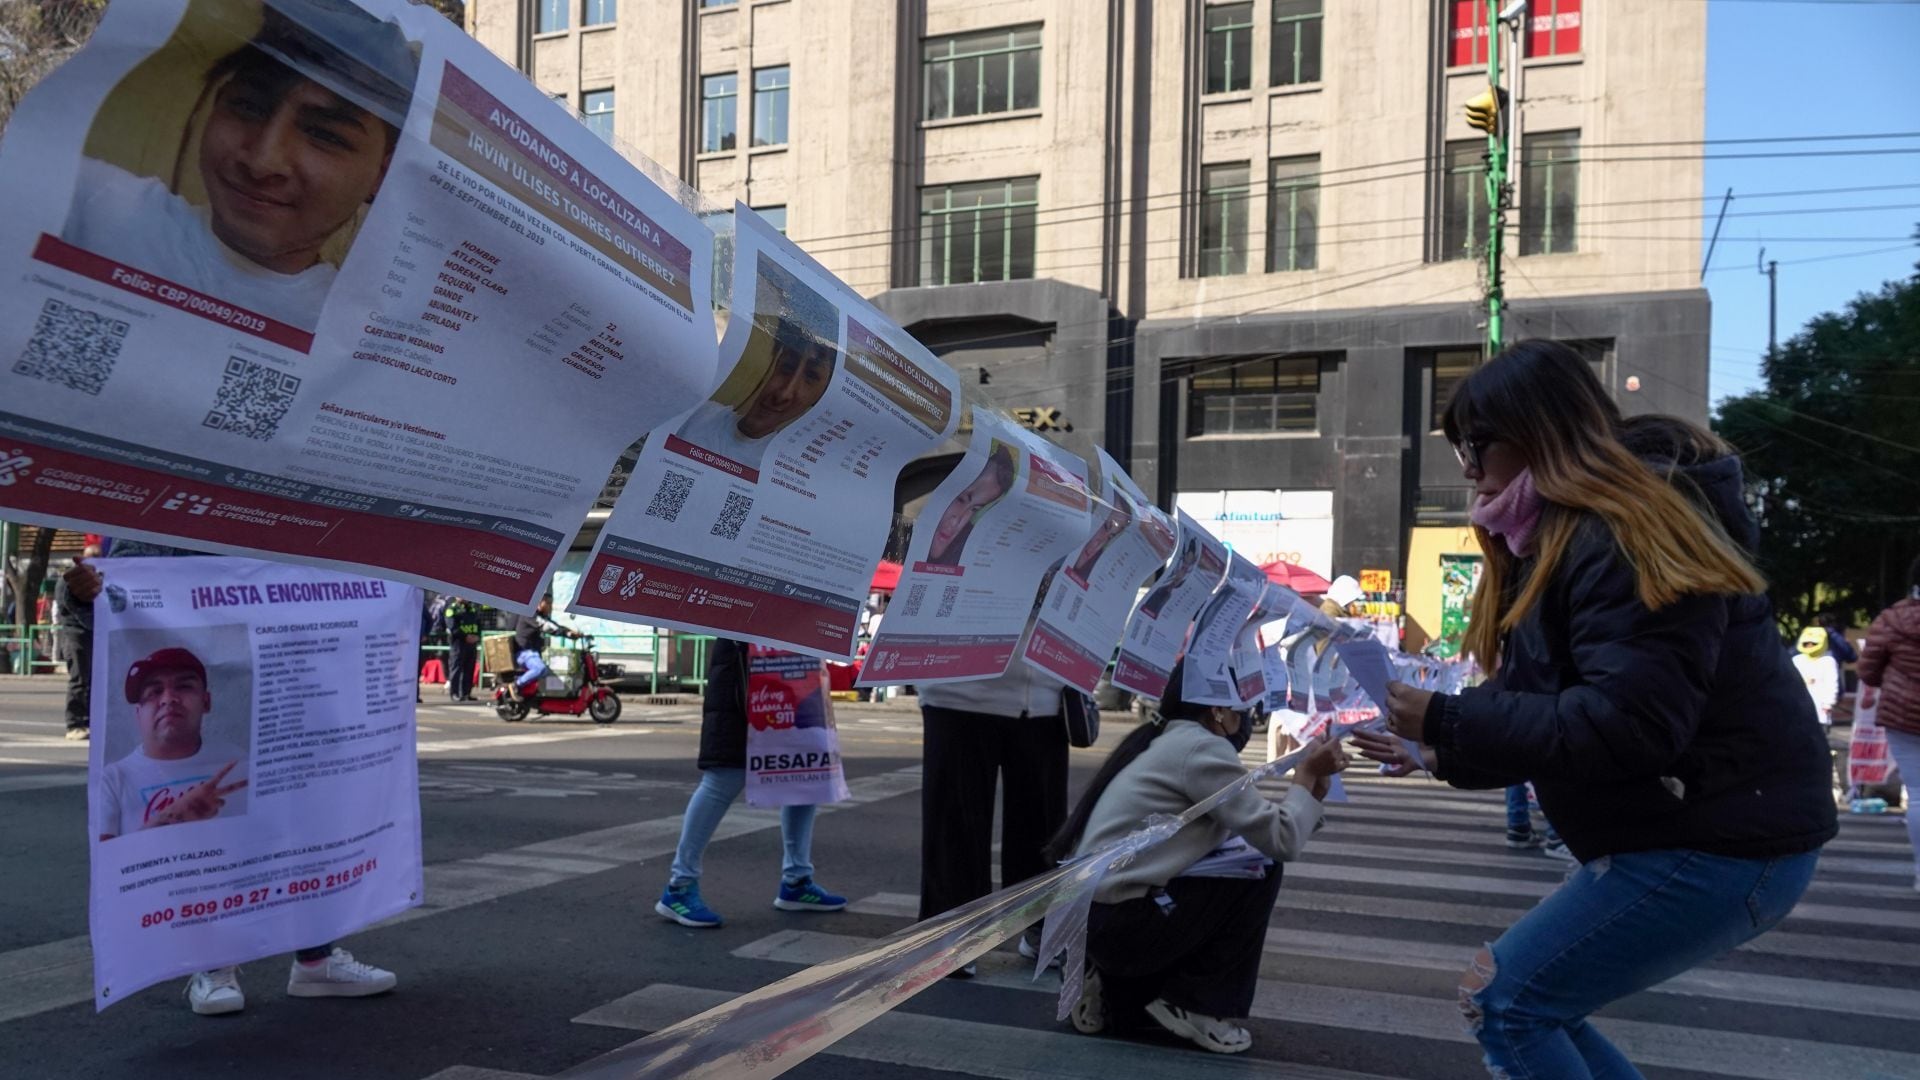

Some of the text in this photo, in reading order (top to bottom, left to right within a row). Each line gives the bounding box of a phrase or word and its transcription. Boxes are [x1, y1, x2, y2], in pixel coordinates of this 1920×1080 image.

[490, 108, 661, 247] AYÚDANOS A LOCALIZAR A
[437, 160, 448, 173] SE
[450, 167, 461, 179] LE
[462, 174, 477, 189] VIO
[479, 184, 496, 201] POR
[497, 196, 526, 218] ULTIMA
[527, 213, 541, 228] VEZ
[542, 222, 552, 235] EN
[552, 232, 569, 246] COL.
[570, 241, 596, 262] PUERTA
[597, 257, 625, 281] GRANDE,
[442, 182, 456, 194] DE
[456, 190, 511, 226] SEPTIEMBRE
[510, 220, 525, 235] DEL
[526, 230, 545, 246] 2019
[468, 132, 676, 287] IRVIN ULISES TORRES GUTIERREZ
[451, 250, 493, 275] ATLETICA
[461, 240, 501, 265] HOMBRE
[438, 272, 475, 294] PEQUEÑA
[444, 260, 508, 296] MORENA CLARA
[111, 267, 156, 293] Folio:
[157, 285, 266, 332] CBP/00049/2019
[433, 286, 463, 303] GRANDE
[421, 312, 462, 331] DEPILADAS
[428, 300, 479, 323] ABUNDANTE Y
[408, 336, 445, 354] MEDIANOS
[579, 345, 604, 361] RECTA
[589, 339, 624, 361] REDONDA
[380, 356, 410, 371] OSCURO
[410, 365, 432, 378] LACIO
[432, 372, 457, 385] CORTO
[561, 357, 602, 379] CUADRADO
[570, 351, 606, 372] GRUESOS
[865, 335, 939, 395] AYÚDANOS A LOCALIZAR A
[320, 402, 343, 416] Señas
[344, 408, 389, 427] particulares
[689, 447, 704, 459] Folio:
[34, 476, 145, 504] CIUDAD DE MÉXICO
[41, 467, 150, 497] GOBIERNO DE LA
[209, 508, 278, 527] DE PERSONAS
[216, 502, 329, 529] COMISIÓN DE BÚSQUEDA
[1215, 512, 1283, 521] infinitum
[487, 565, 522, 580] DERECHOS
[494, 556, 535, 573] INNOVADORA
[190, 580, 387, 610] ¡HASTA ENCONTRARLE!
[645, 579, 672, 591] GOBIERNO
[255, 624, 289, 635] CARLOS
[752, 702, 793, 713] LLAMA AL
[775, 711, 795, 724] 911
[761, 776, 773, 784] EN
[120, 856, 170, 875] VESTIMENTA
[179, 848, 226, 861] CALZADO:
[141, 908, 175, 928] 800
[181, 900, 218, 918] 509
[223, 894, 244, 909] 09
[249, 887, 270, 904] 27
[288, 877, 321, 895] 800
[325, 869, 350, 888] 216
